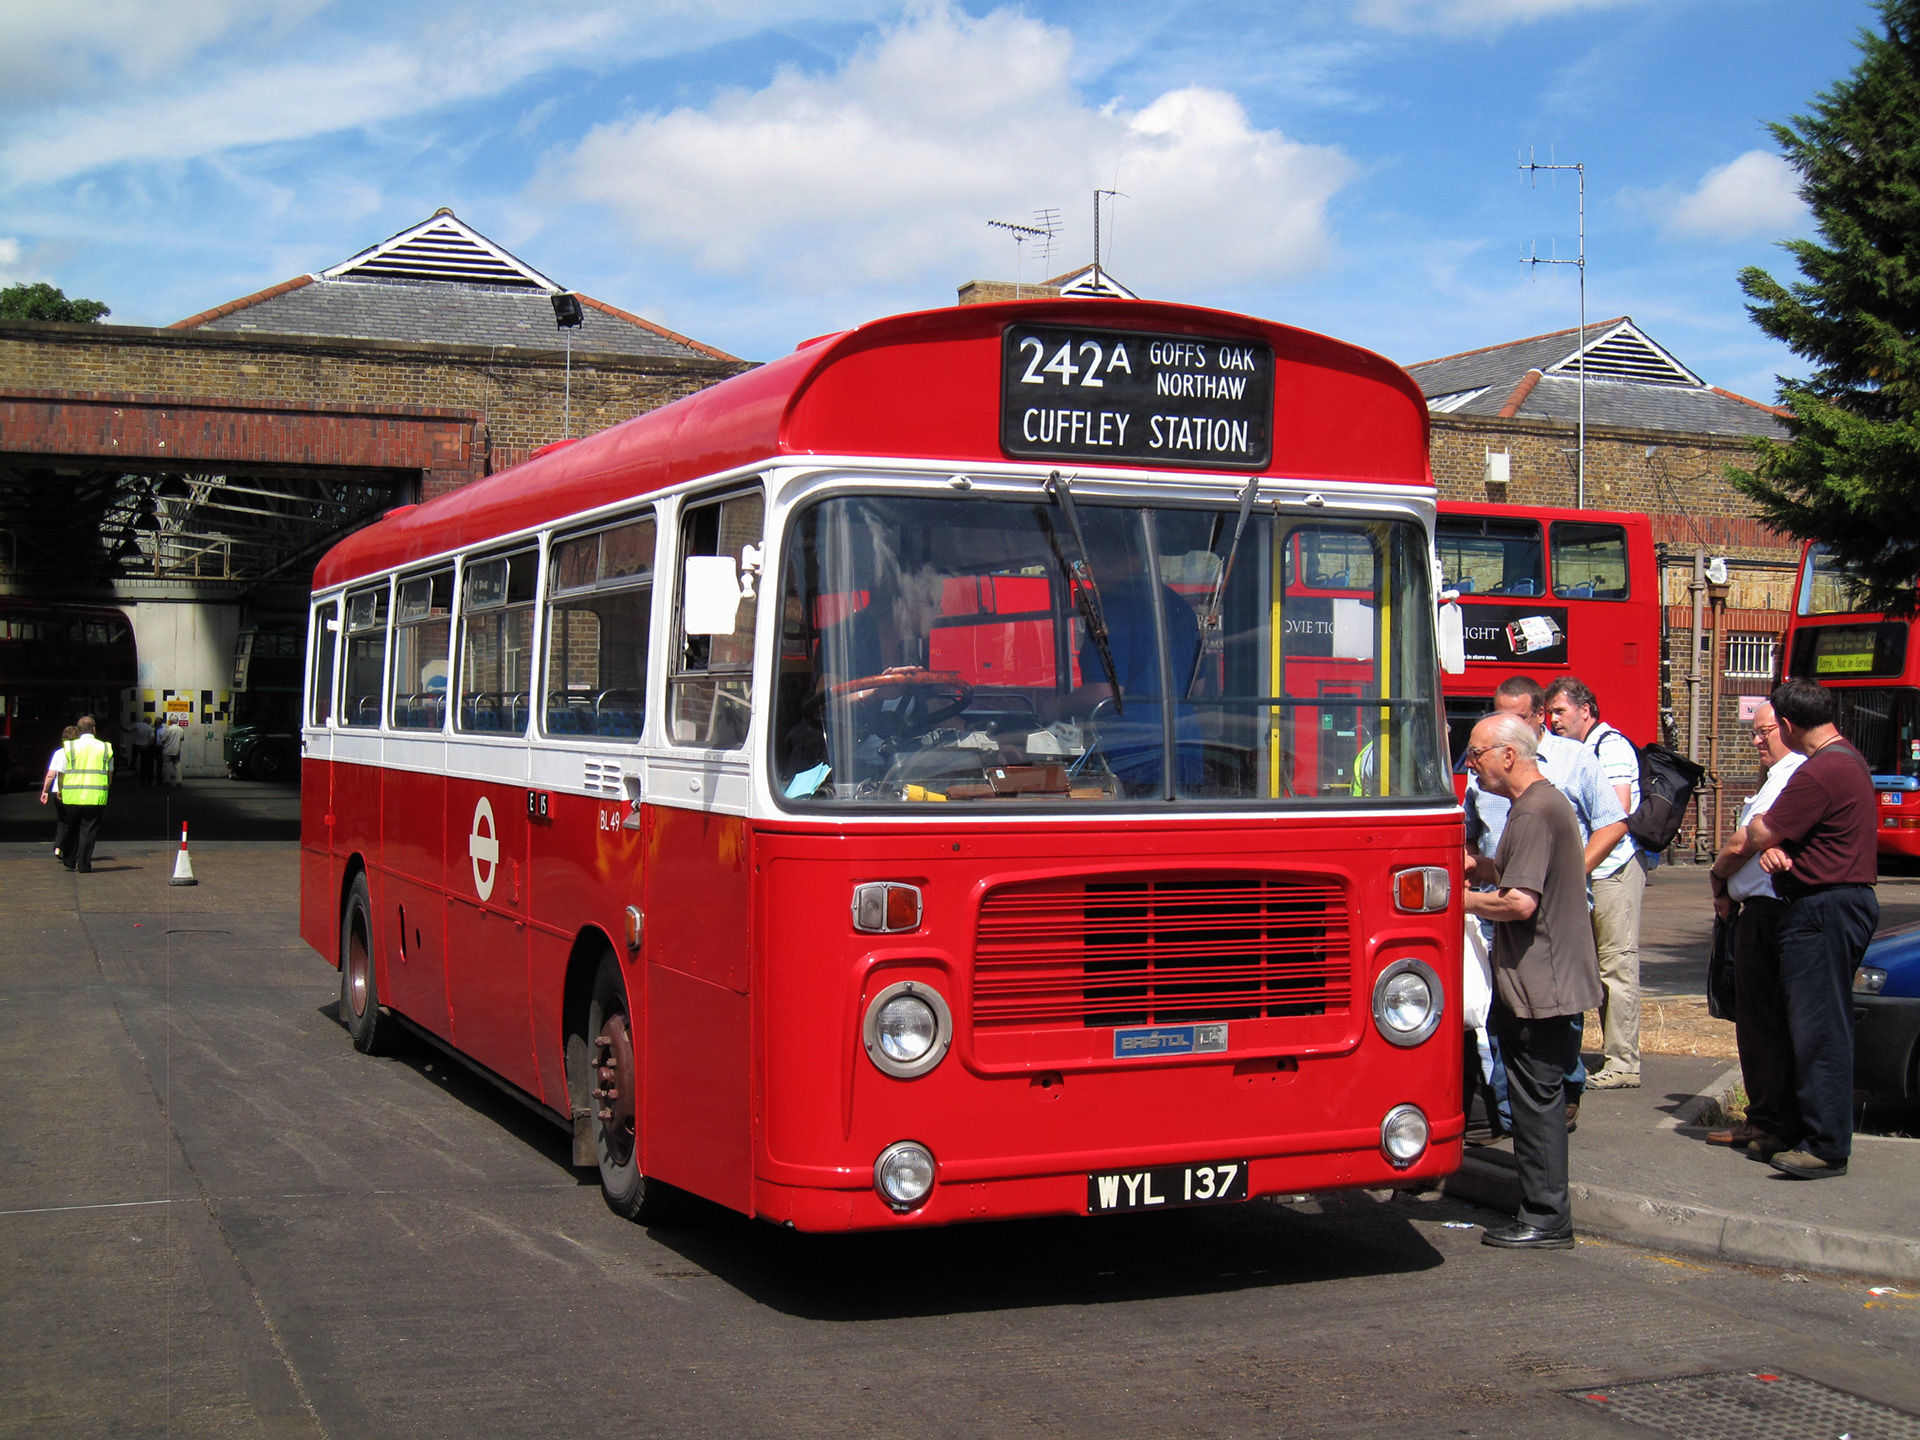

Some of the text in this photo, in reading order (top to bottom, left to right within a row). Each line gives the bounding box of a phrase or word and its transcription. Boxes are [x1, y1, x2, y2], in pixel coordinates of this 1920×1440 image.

[1019, 336, 1132, 388] 242A
[1150, 341, 1256, 372] GOFFS OAK
[1156, 372, 1247, 400] NORTHAW
[1022, 407, 1249, 453] CUFFLEY STATION
[1836, 657, 1846, 669] Not
[529, 792, 534, 812] E
[600, 809, 620, 832] BL 49
[1121, 1033, 1190, 1050] BRISTOL
[1097, 1164, 1239, 1209] WYL 137
